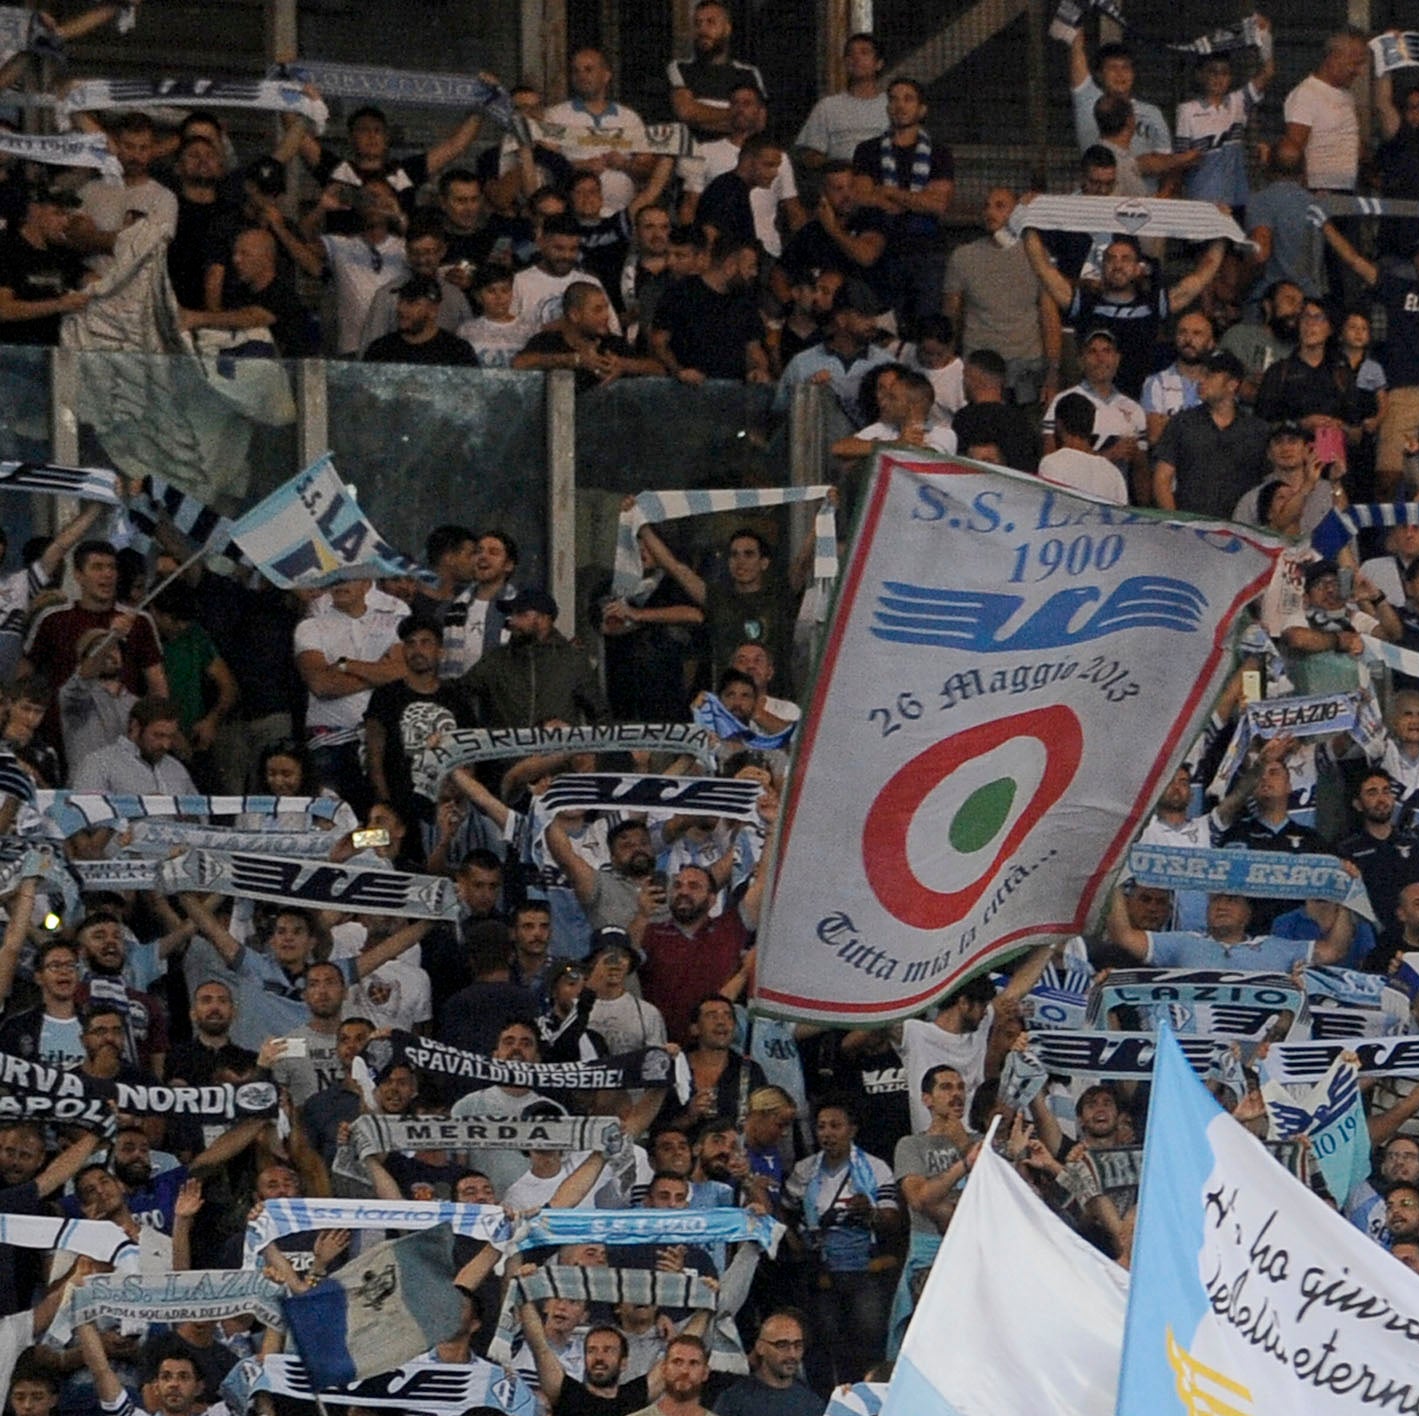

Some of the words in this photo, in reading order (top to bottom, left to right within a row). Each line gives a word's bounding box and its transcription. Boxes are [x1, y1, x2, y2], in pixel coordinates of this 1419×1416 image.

[1007, 533, 1126, 584] 1900
[868, 690, 924, 737] 26
[938, 660, 1080, 711] Maggio
[1079, 654, 1141, 704] 2013
[1278, 701, 1338, 727] LAZIO
[815, 910, 900, 984] Tutta
[901, 947, 952, 983] mia
[958, 925, 978, 957] la
[1114, 986, 1288, 1005] LAZIO
[115, 1081, 226, 1113] NORD
[407, 1125, 554, 1141] MERDA
[1248, 1209, 1289, 1282] ho
[138, 1307, 198, 1321] SQUADRA
